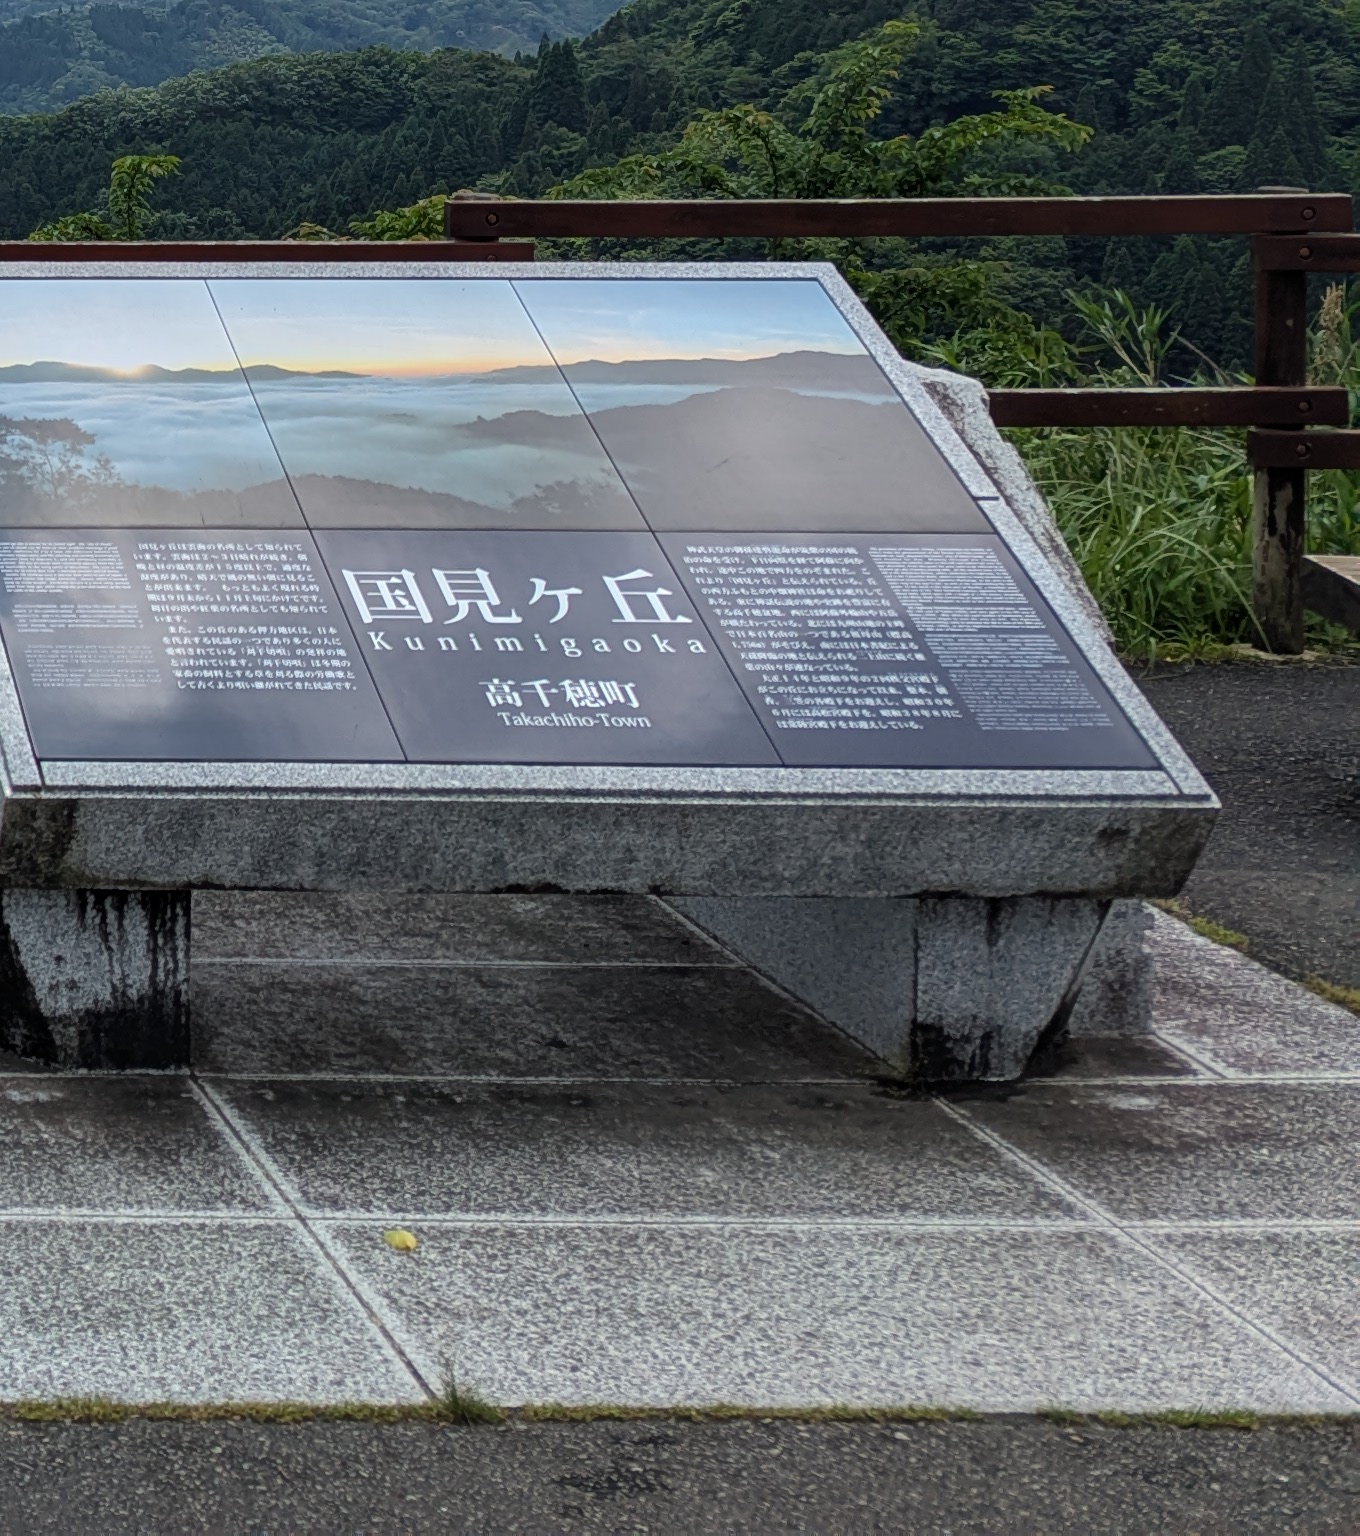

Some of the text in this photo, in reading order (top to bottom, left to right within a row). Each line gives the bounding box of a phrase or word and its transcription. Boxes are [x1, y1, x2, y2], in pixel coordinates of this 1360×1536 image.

[368, 631, 708, 658] Kunimigaoka
[479, 677, 640, 709] 高千穂町
[497, 711, 652, 729] Takachiho-Town
